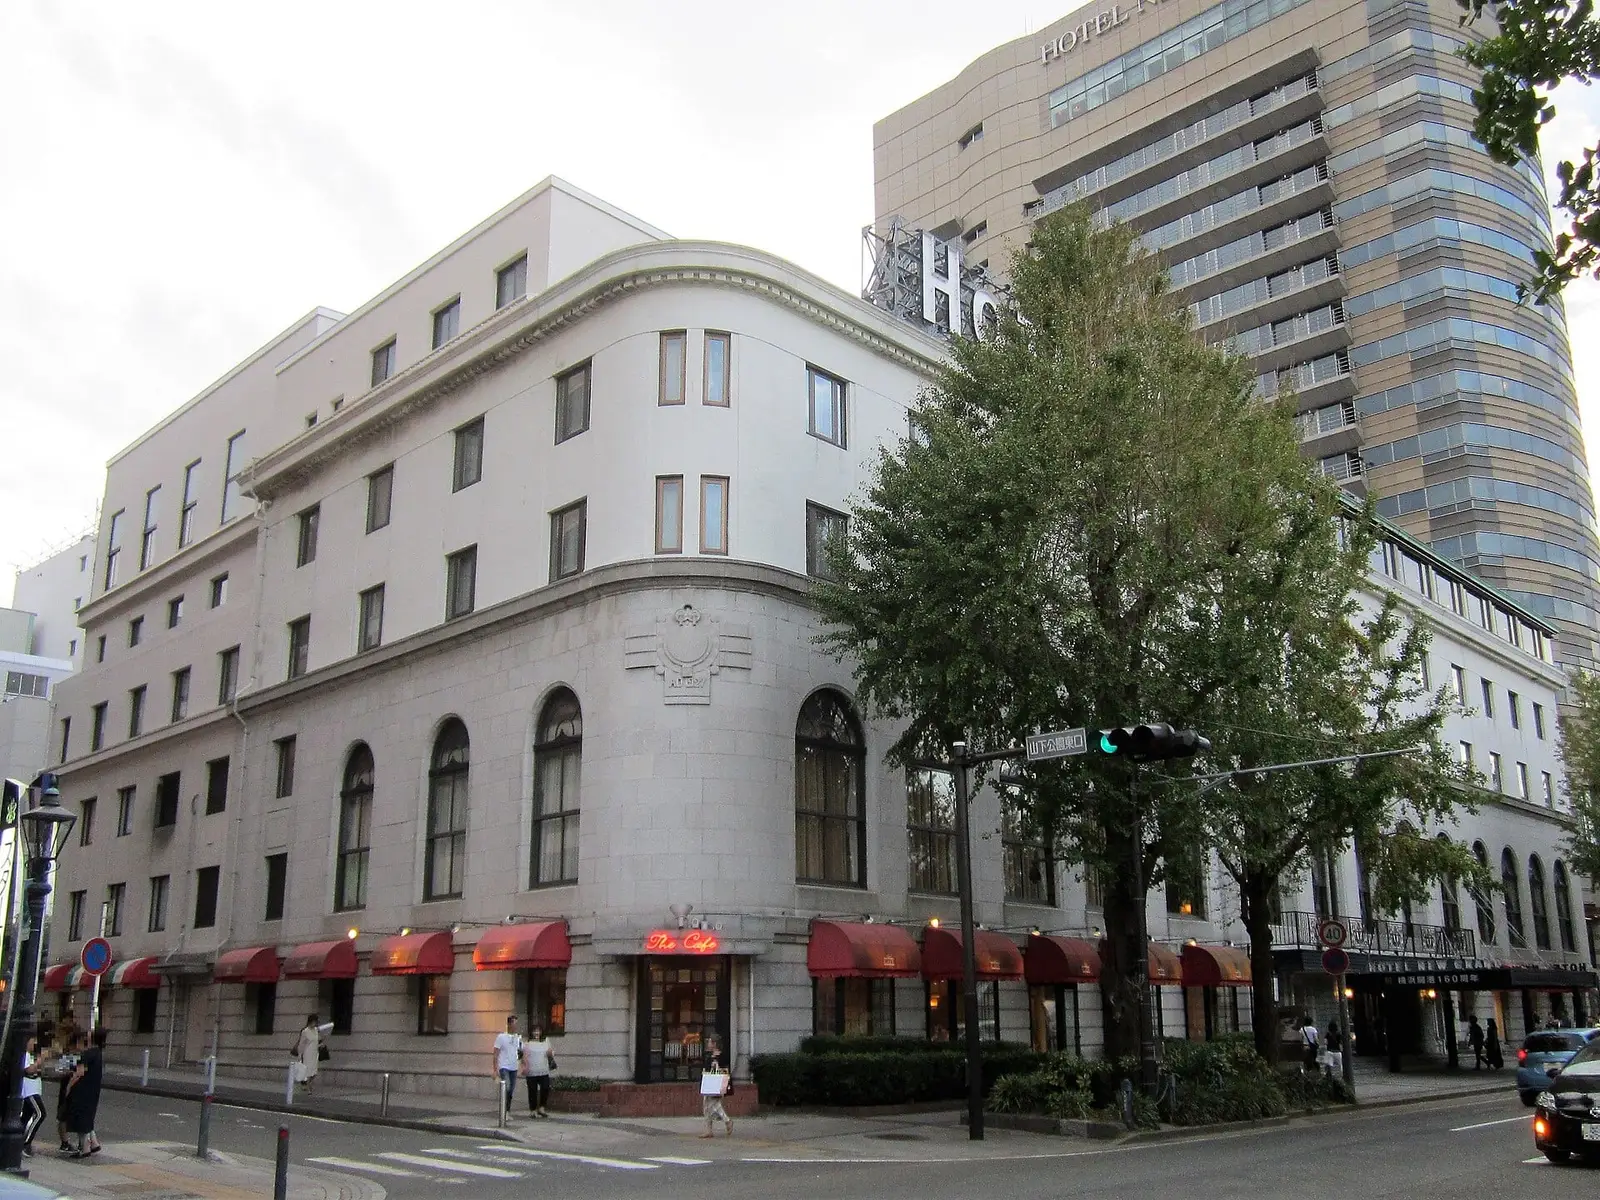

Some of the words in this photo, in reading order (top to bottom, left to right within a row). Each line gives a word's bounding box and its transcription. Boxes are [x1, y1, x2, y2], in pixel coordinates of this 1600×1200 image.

[1040, 4, 1130, 65] HOTEL
[1029, 735, 1083, 755] 山下公園東口
[646, 933, 677, 949] The
[684, 932, 717, 952] Cafe
[1326, 928, 1340, 940] 40
[1368, 961, 1411, 972] HOTEL
[1417, 960, 1447, 971] NEW
